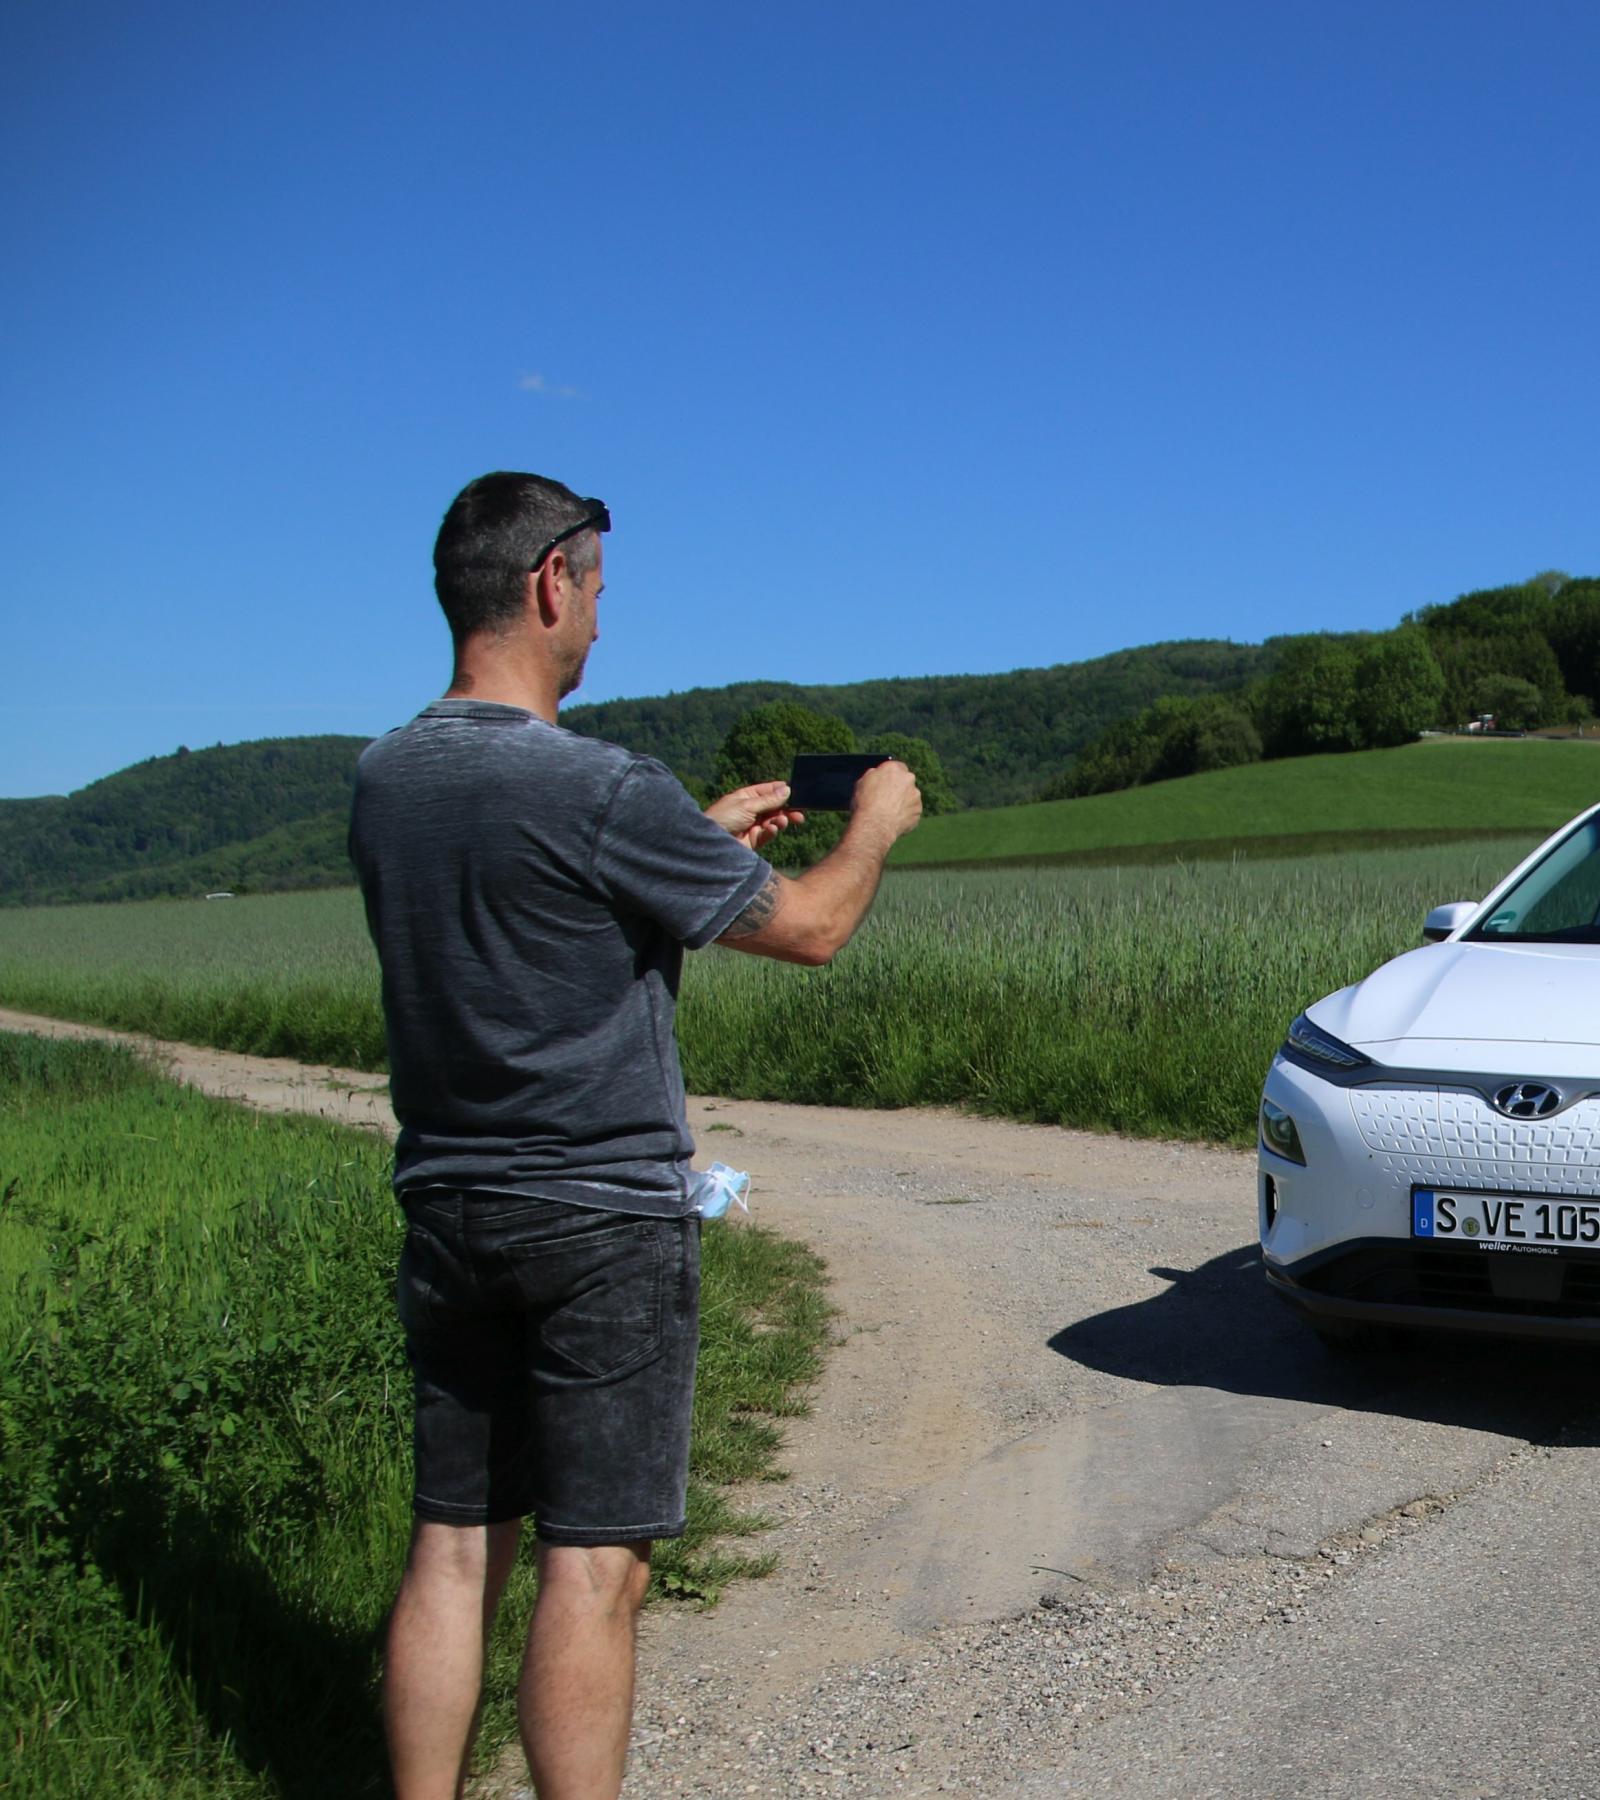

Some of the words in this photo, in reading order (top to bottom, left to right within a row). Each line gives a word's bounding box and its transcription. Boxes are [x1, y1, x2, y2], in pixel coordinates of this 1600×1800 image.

[1420, 1217, 1428, 1228] D
[1436, 1197, 1458, 1234] S
[1482, 1200, 1526, 1239] VE
[1511, 1245, 1559, 1255] AUTOMOBILE
